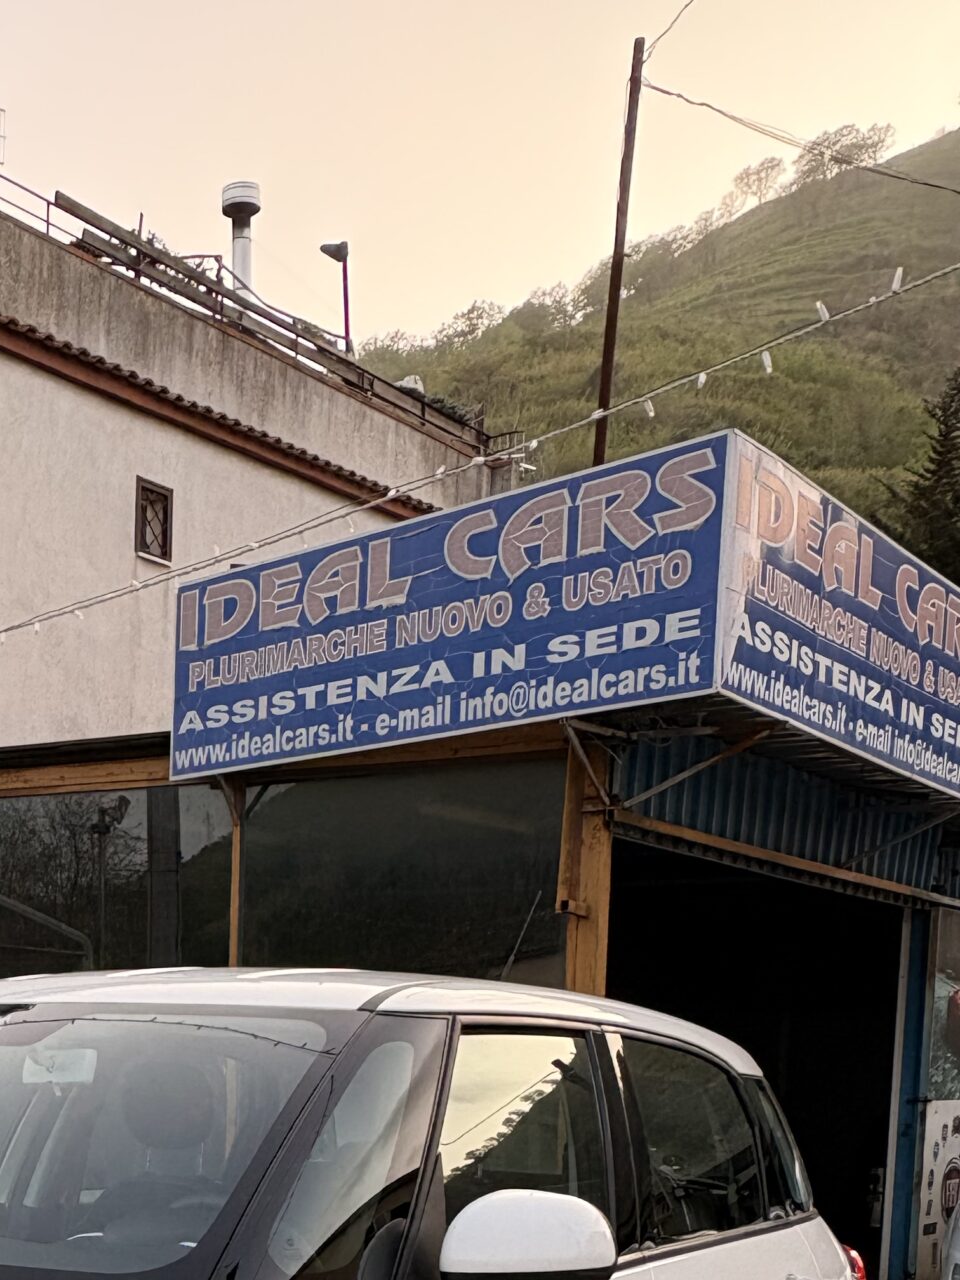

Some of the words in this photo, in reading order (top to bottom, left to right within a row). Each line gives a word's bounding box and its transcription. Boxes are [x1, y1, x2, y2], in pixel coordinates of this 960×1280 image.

[179, 537, 412, 651] IDEAL
[444, 448, 717, 583] CARS
[736, 454, 882, 610] IDEAL
[178, 660, 455, 734] ASSISTENZA
[472, 643, 526, 677] IN
[547, 609, 702, 664] SEDE
[188, 619, 388, 692] PLURIMARCHE
[395, 591, 513, 649] NUOVO
[522, 583, 551, 620] &
[562, 549, 692, 612] USATO
[736, 613, 894, 717] ASSISTENZA
[900, 697, 925, 730] IN
[871, 627, 920, 686] NUOVO
[923, 660, 935, 694] &
[174, 712, 354, 769] www.idealcars.it
[375, 696, 451, 737] e-mail
[459, 651, 700, 723] info@idealcars.it
[727, 660, 847, 736] www.idealcars.it
[855, 717, 891, 753] e-mail
